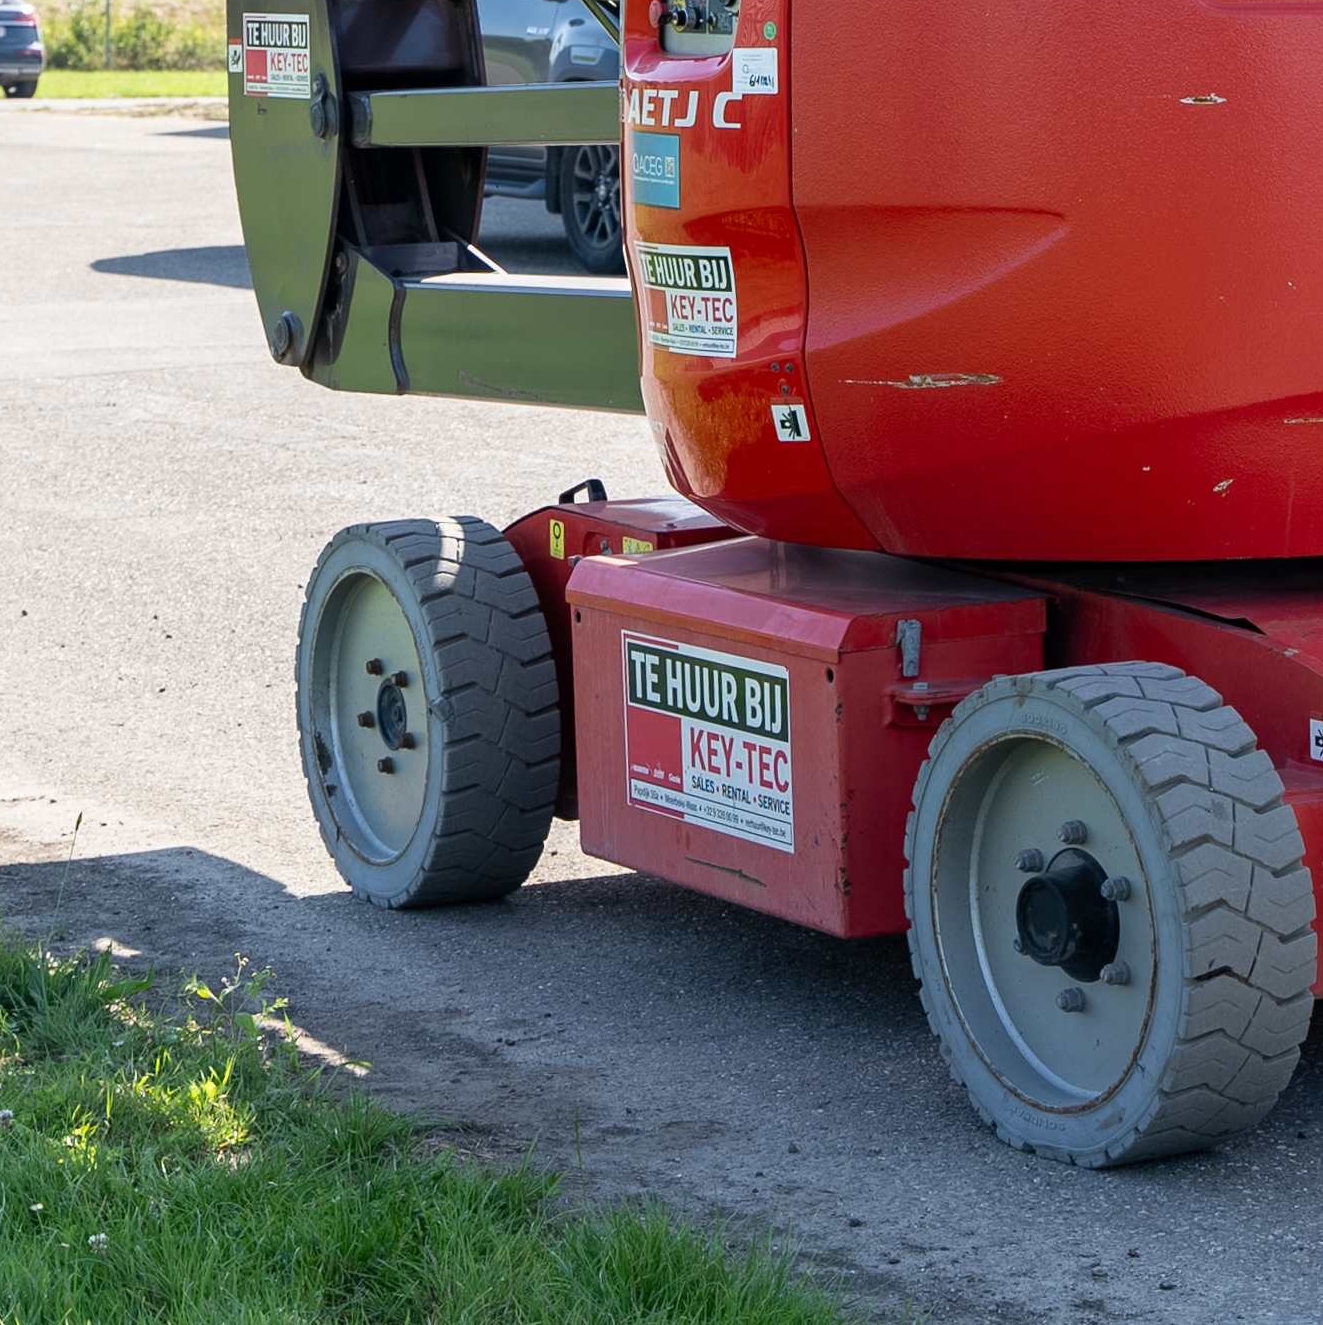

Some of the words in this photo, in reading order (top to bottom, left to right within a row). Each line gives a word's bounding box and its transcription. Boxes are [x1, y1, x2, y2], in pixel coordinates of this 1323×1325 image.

[247, 23, 259, 45] TE
[261, 23, 290, 46] HUUR
[291, 24, 306, 48] BIJ
[270, 52, 309, 73] KEY-TEC
[640, 251, 656, 283] TE
[655, 255, 698, 288] HUUR
[699, 259, 727, 290] BIJ
[670, 293, 734, 324] KEY-TEC
[630, 650, 661, 703] TE
[666, 658, 738, 723] HUUR
[745, 677, 782, 734] BIJ
[690, 726, 790, 793] KEY-TEC
[691, 775, 715, 794] SALES
[722, 783, 752, 805] RENTAL
[758, 794, 790, 815] SERVICE
